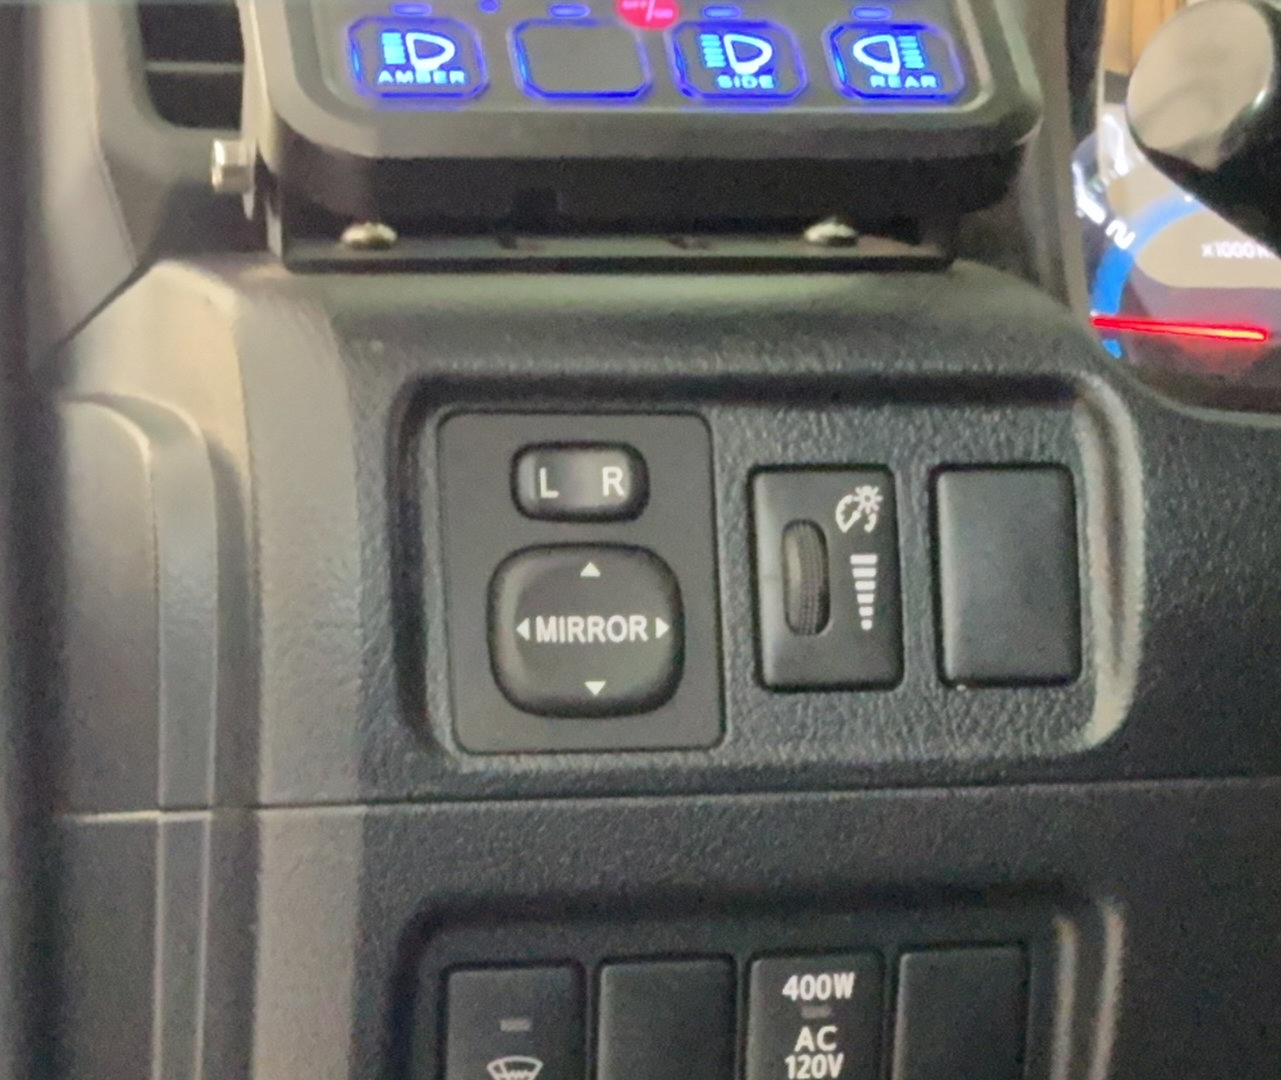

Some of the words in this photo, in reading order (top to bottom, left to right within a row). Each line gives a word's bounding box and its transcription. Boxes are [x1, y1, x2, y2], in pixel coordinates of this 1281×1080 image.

[377, 69, 466, 84] AMBER
[717, 75, 775, 89] SIDE
[869, 75, 938, 89] REAR
[539, 466, 560, 499] L
[601, 466, 625, 497] R
[535, 614, 649, 644] MIRROR
[781, 971, 856, 1002] 400W
[794, 1024, 838, 1052] AC
[784, 1052, 845, 1080] 120V
